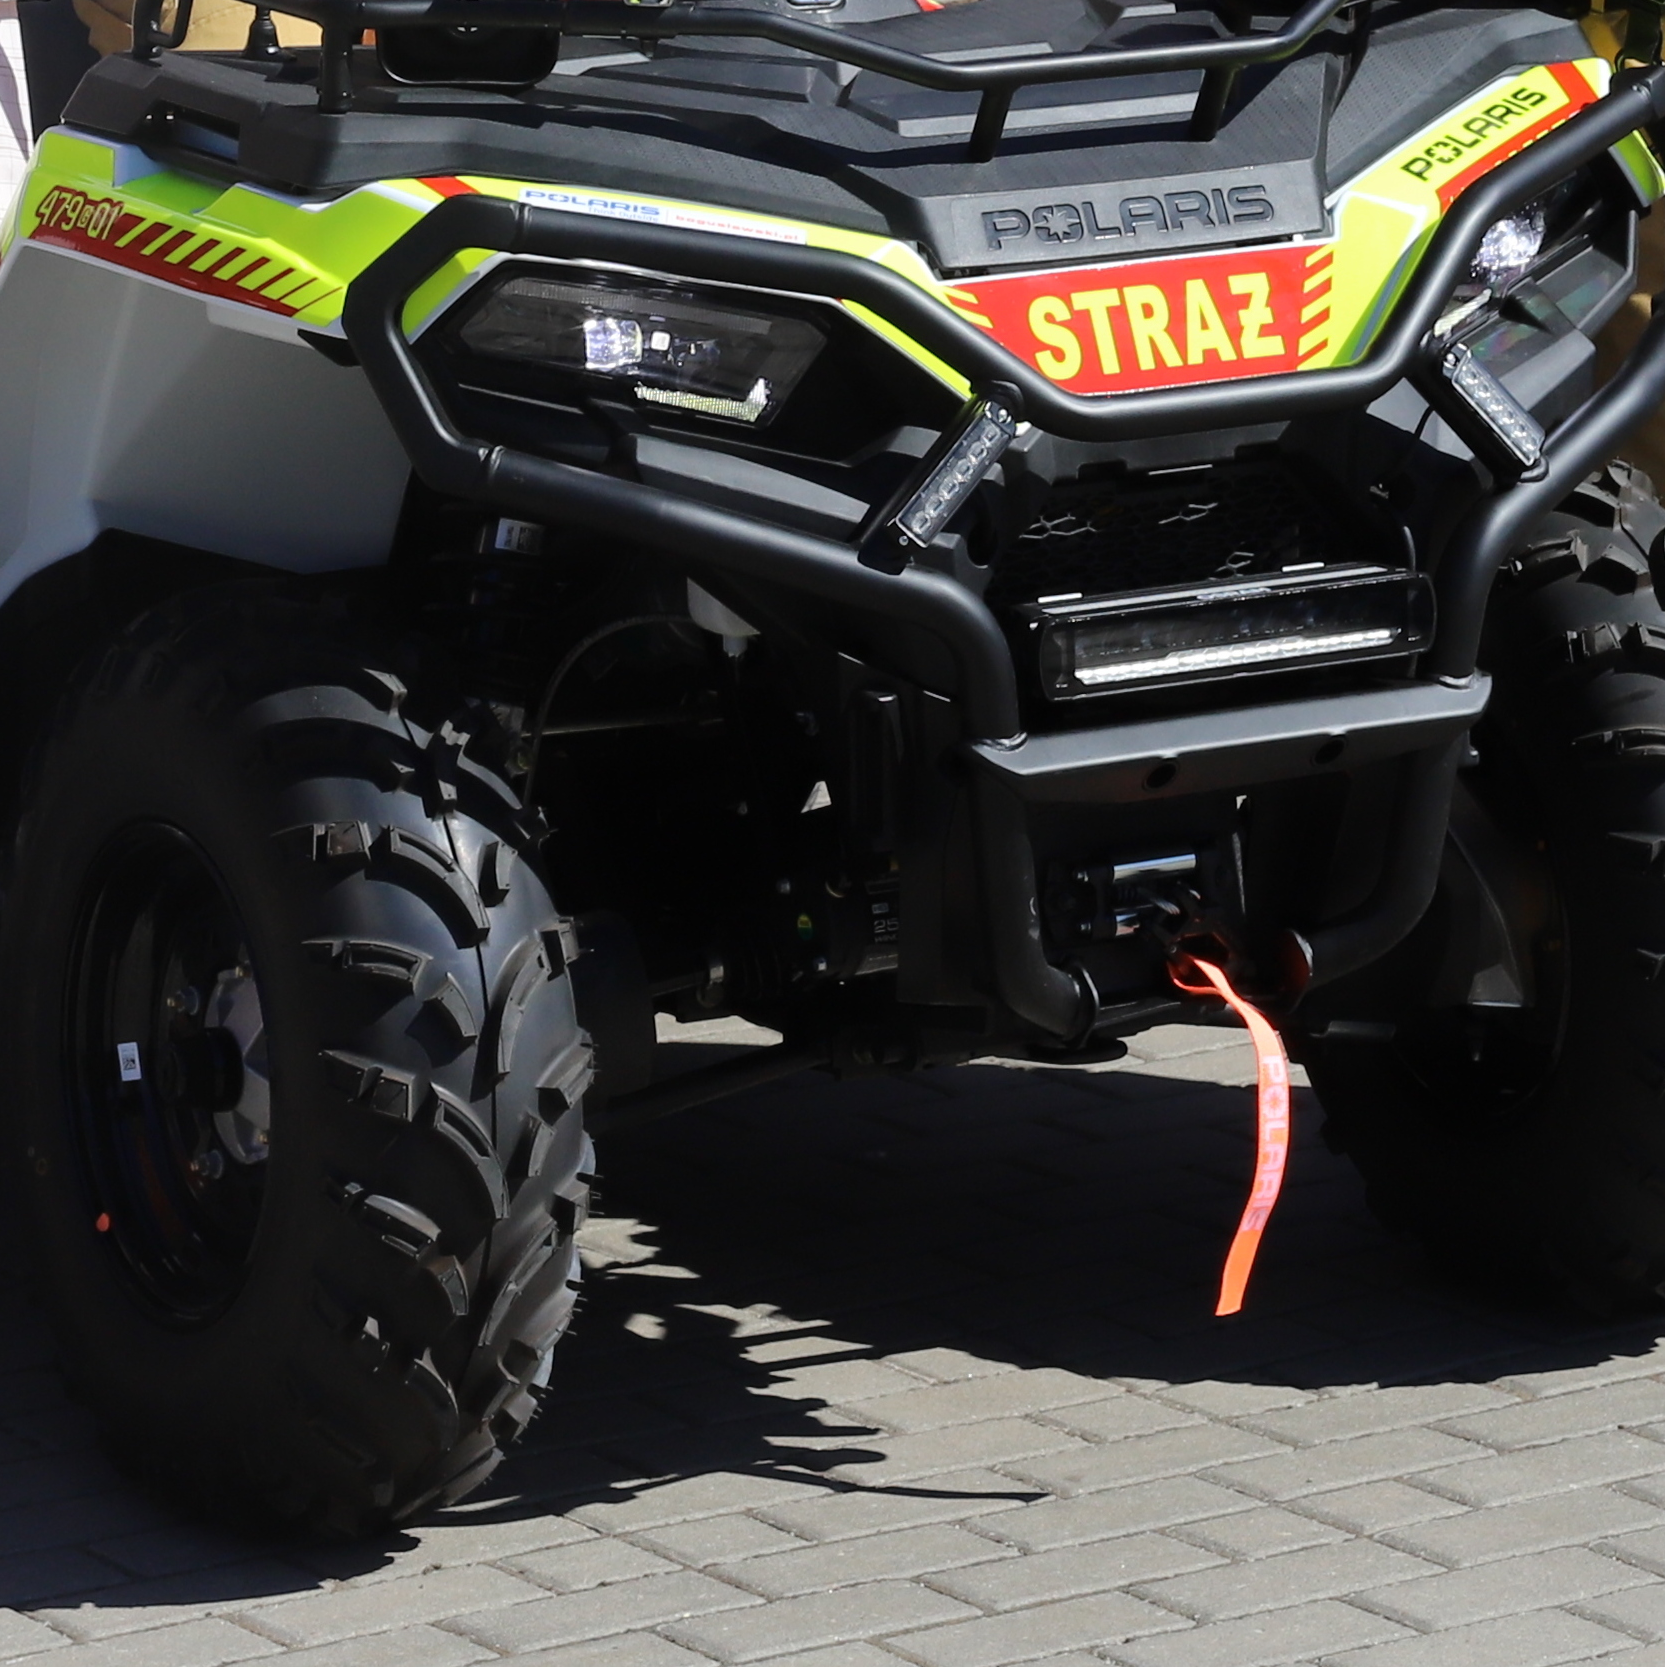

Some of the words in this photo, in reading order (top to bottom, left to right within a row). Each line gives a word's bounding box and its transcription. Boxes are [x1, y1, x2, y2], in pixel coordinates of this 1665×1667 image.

[1400, 87, 1548, 181] POLARIS
[525, 190, 661, 217] POLARIS
[981, 184, 1275, 251] POLARIS
[1028, 272, 1285, 380] STRAŻ
[1241, 1055, 1287, 1231] POLARIS
